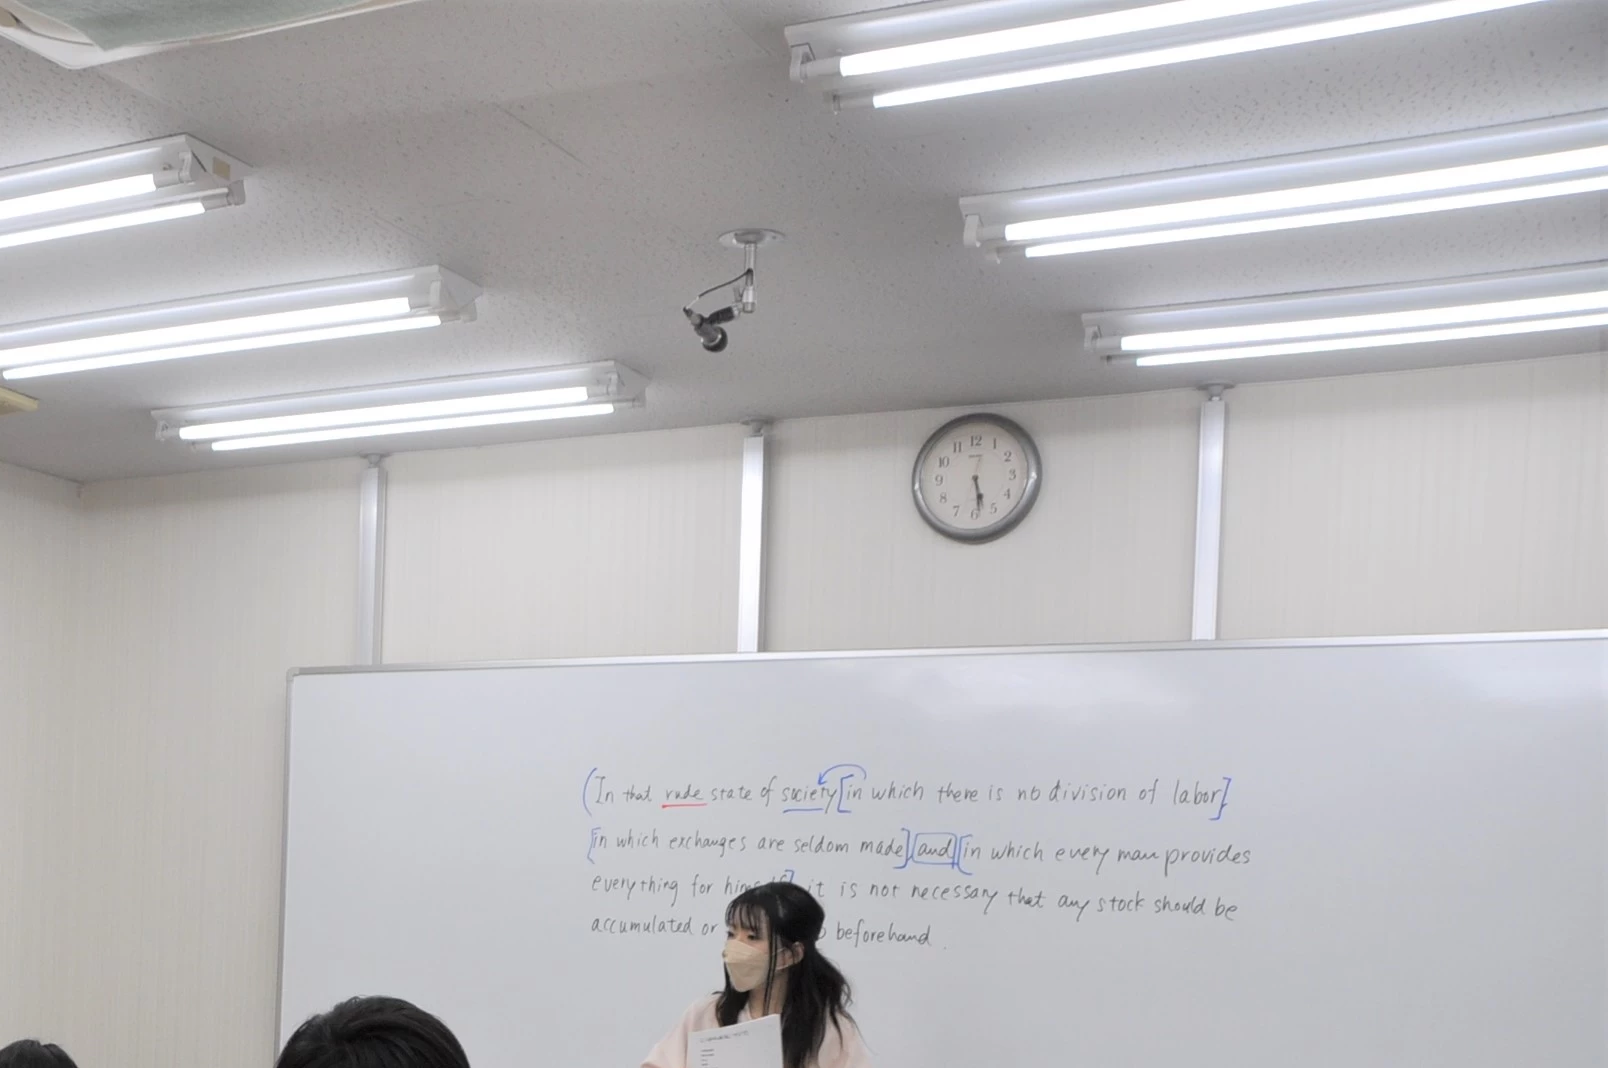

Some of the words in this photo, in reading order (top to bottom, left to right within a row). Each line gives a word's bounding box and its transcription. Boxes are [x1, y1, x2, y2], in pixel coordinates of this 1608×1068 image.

[953, 441, 962, 453] 11
[970, 435, 982, 447] 12
[993, 438, 997, 449] 1
[938, 456, 950, 468] 10
[1004, 451, 1012, 462] 2
[935, 474, 943, 486] 9
[1009, 469, 1017, 481] 3
[939, 493, 947, 504] 8
[1003, 489, 1011, 500] 4
[953, 505, 960, 517] 7
[970, 508, 979, 520] 6
[990, 503, 998, 514] 5
[622, 783, 653, 803] that
[665, 785, 705, 801] rude
[711, 784, 754, 802] state
[760, 775, 778, 807] of
[871, 777, 924, 802] which
[937, 778, 980, 805] there
[988, 781, 1005, 802] is
[1017, 782, 1041, 801] no
[1048, 778, 1128, 802] division
[1138, 777, 1160, 806] of
[616, 828, 660, 849] which
[669, 830, 747, 859] exchanges
[757, 835, 786, 852] are
[794, 830, 850, 855] seldom
[916, 837, 953, 859] and
[990, 840, 1044, 863] which
[1054, 845, 1111, 875] every
[1117, 849, 1159, 863] man
[1164, 843, 1252, 877] provides
[592, 873, 680, 908] everything
[691, 873, 713, 897] for
[807, 873, 825, 899] it
[840, 874, 858, 899] is
[869, 875, 901, 899] not
[910, 883, 999, 915] necessary
[1007, 888, 1047, 910] that
[1057, 895, 1091, 922] any
[1097, 890, 1146, 914] stock
[1154, 894, 1206, 917] should
[1214, 896, 1240, 922] be
[591, 914, 695, 936] accumulated
[700, 919, 720, 936] or
